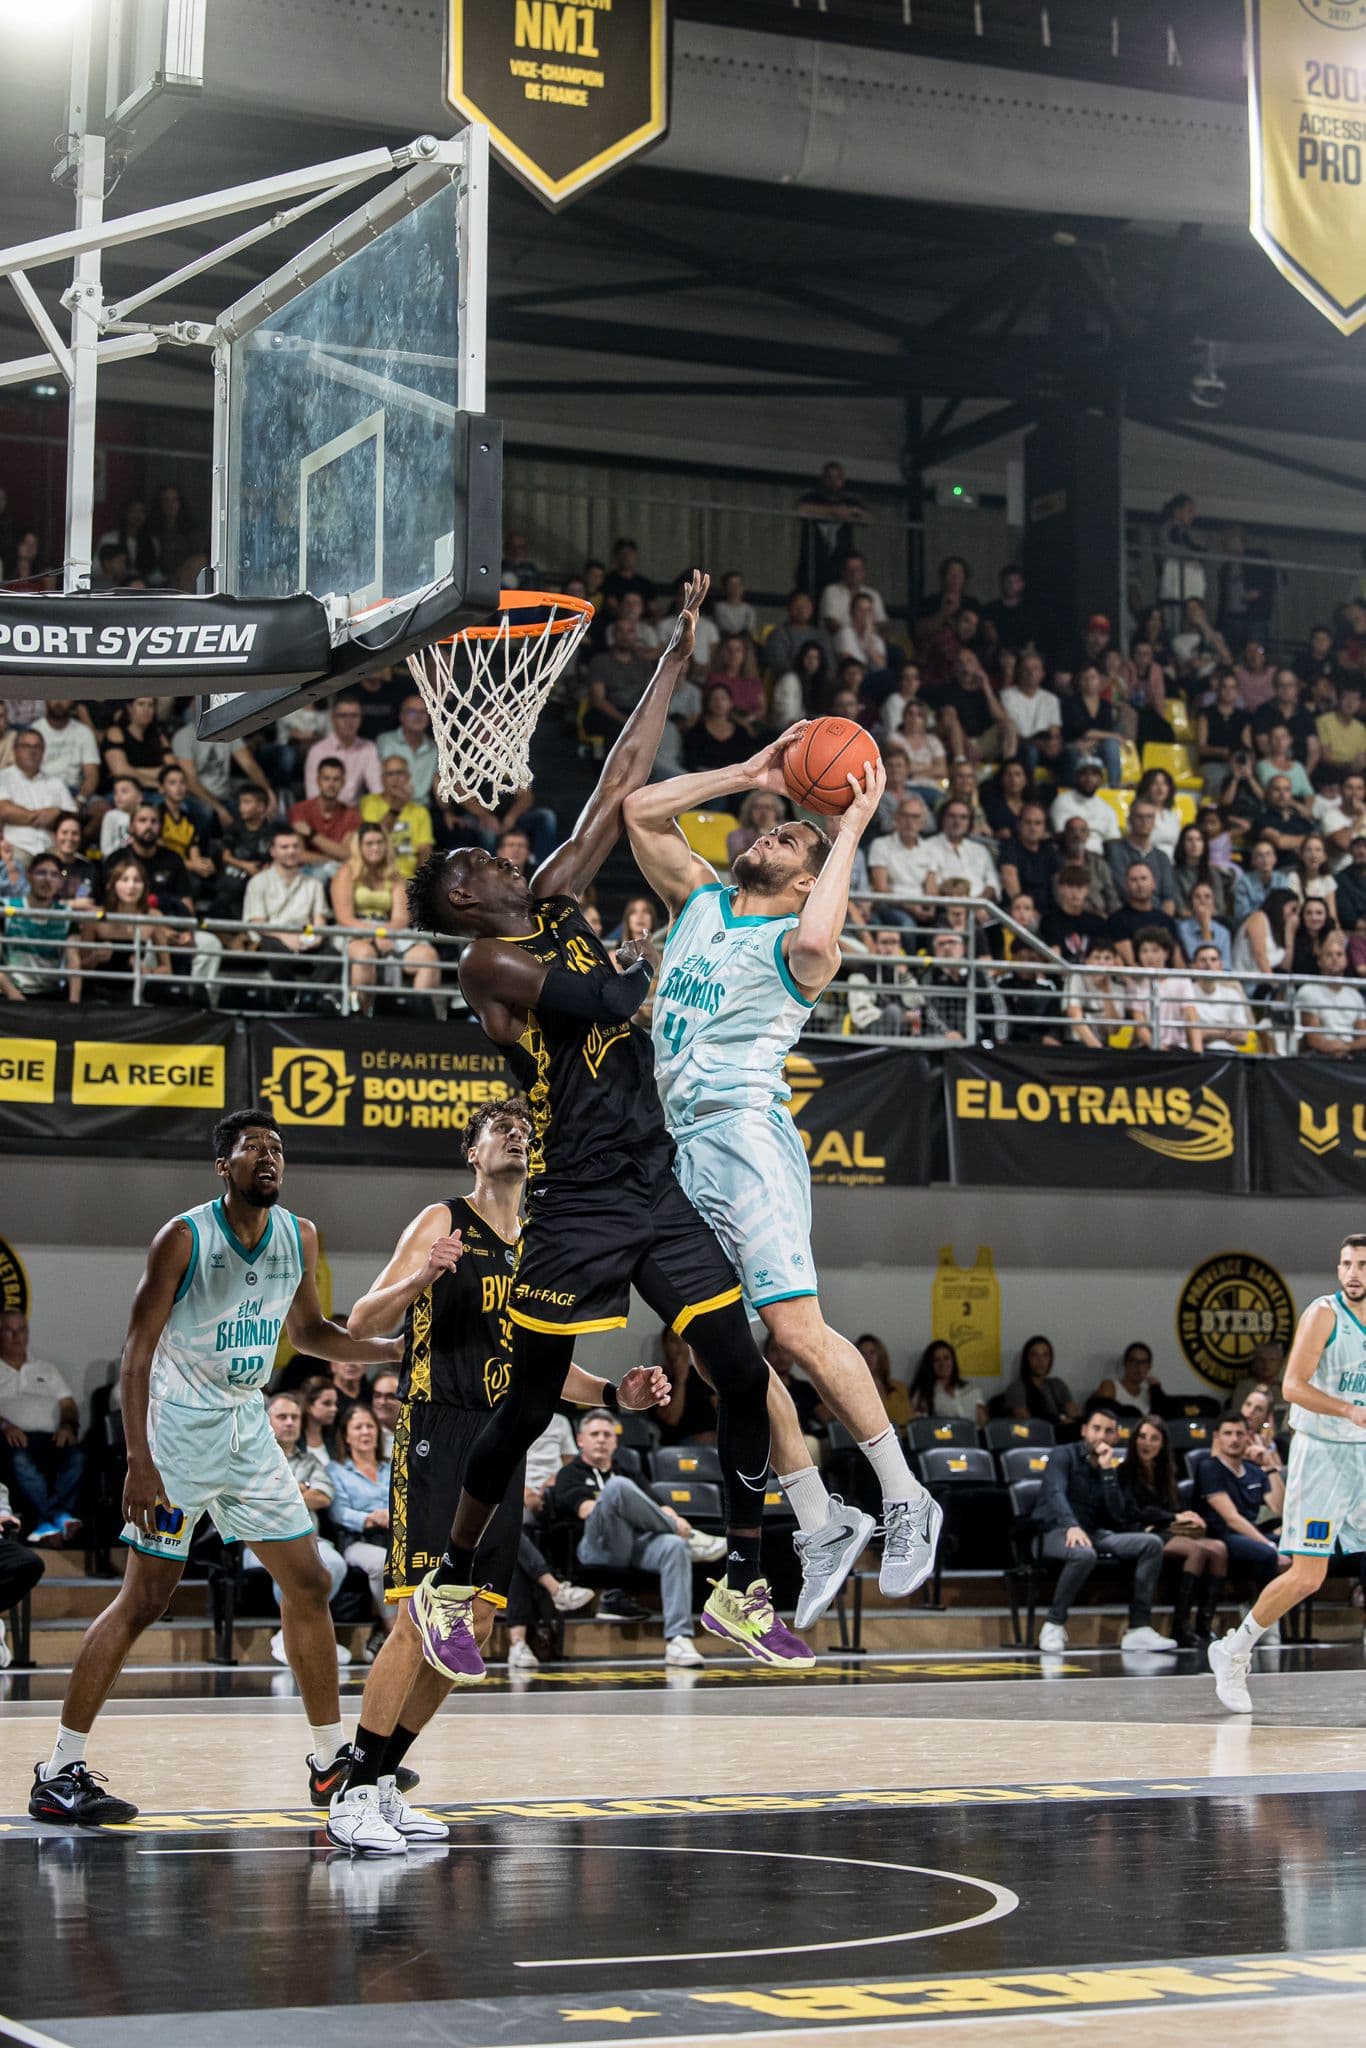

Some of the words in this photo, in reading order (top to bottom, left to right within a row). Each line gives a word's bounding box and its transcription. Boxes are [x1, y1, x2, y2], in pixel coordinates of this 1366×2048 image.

[514, 1, 599, 58] NM1
[510, 58, 605, 88] VICE-CHAMPION
[1305, 60, 1366, 103] 200
[525, 83, 541, 100] DE
[542, 85, 589, 107] FRANCE
[1298, 136, 1362, 185] PRO
[96, 624, 257, 665] SYSTEM
[663, 1011, 688, 1055] 4
[84, 1063, 118, 1085] LA
[129, 1065, 214, 1087] REGIE
[361, 1050, 506, 1072] DÉPARTEMENT
[956, 1078, 1192, 1126] ELOTRANS
[1200, 1309, 1274, 1334] BYERS
